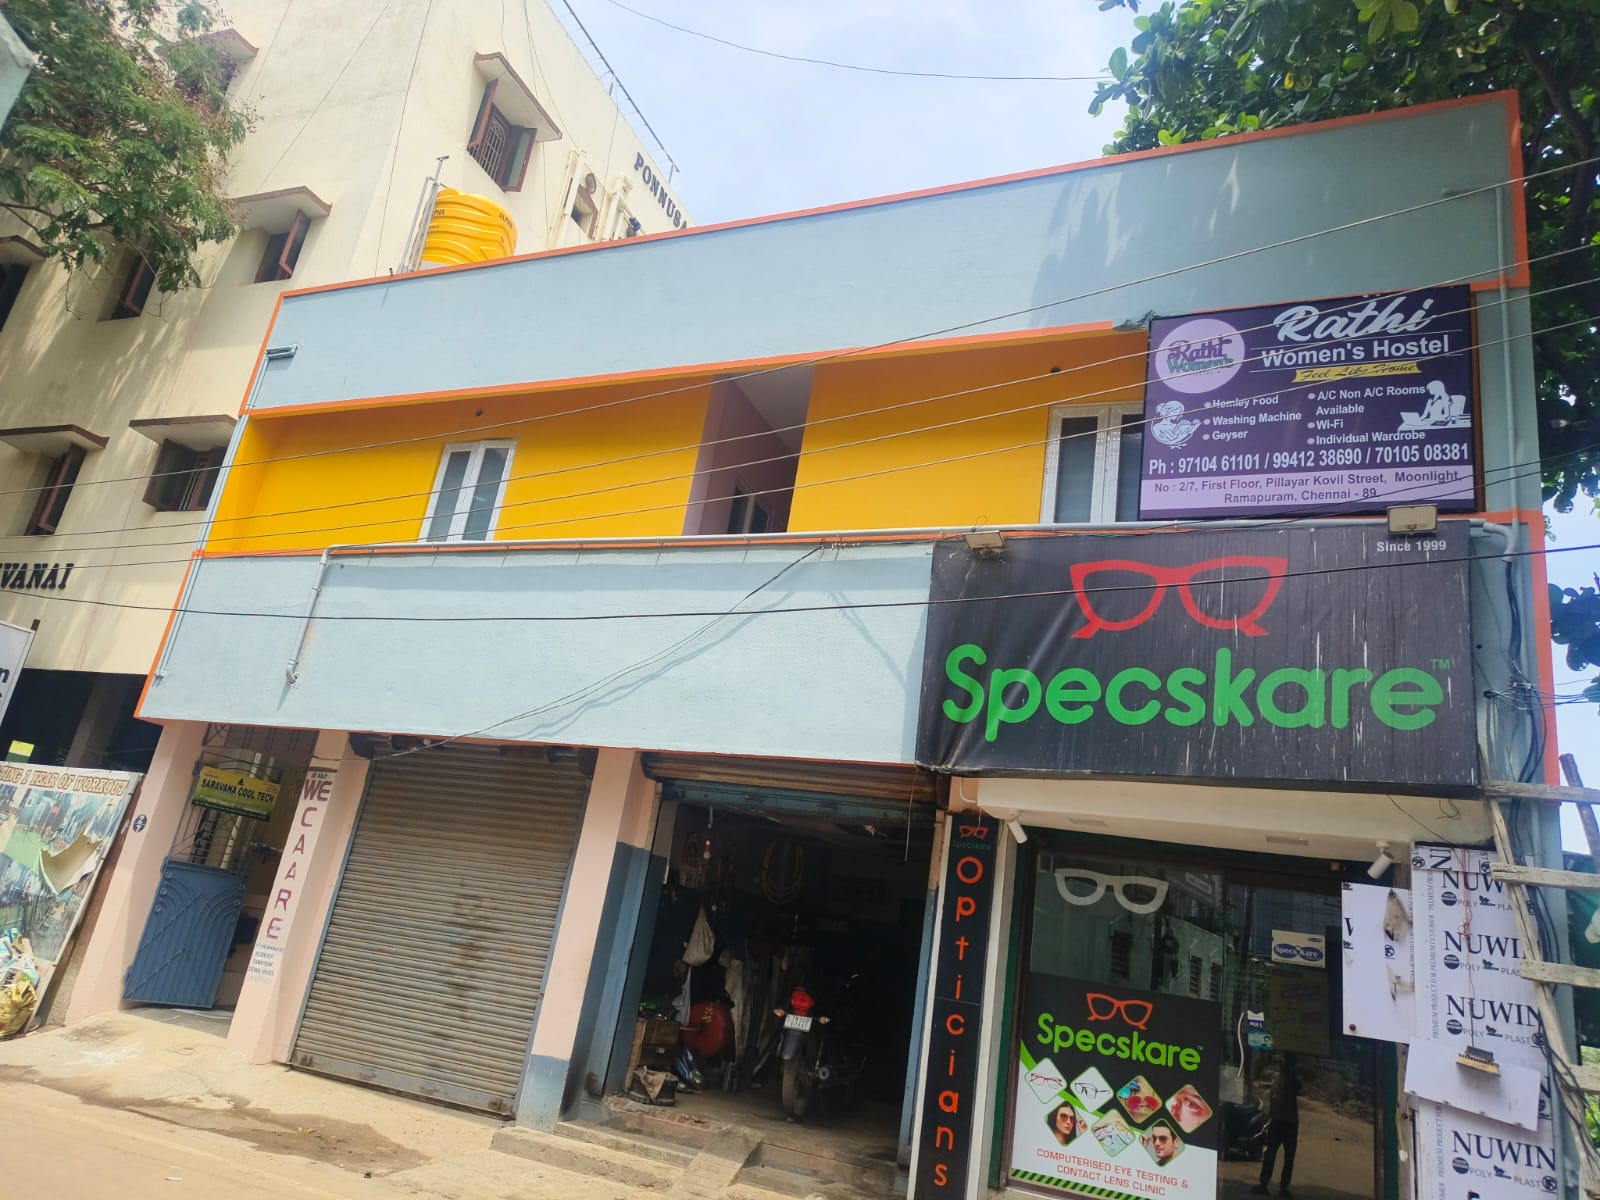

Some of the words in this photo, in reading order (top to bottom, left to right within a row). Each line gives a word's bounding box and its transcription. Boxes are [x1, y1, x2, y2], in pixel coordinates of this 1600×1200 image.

[1273, 296, 1437, 342] Rathi
[1261, 343, 1365, 367] Women's
[1373, 334, 1449, 358] Hostel
[1300, 369, 1329, 381] Feel
[1253, 395, 1279, 406] Food
[1317, 391, 1336, 401] A/C
[1340, 390, 1361, 399] Non
[1364, 387, 1384, 397] A/C
[1386, 386, 1426, 396] Rooms
[1212, 415, 1256, 426] Washing
[1258, 411, 1302, 422] Machine
[1316, 404, 1365, 416] Available
[1212, 430, 1248, 442] Geyser
[1316, 419, 1344, 430] Wi-Fi
[1316, 433, 1369, 445] Individual
[1372, 430, 1426, 443] Wardrobe
[1149, 459, 1166, 475] Ph
[1178, 456, 1217, 474] 97104
[1221, 453, 1260, 471] 61101
[1272, 450, 1315, 469] 99412
[1319, 448, 1362, 466] 38690
[1375, 445, 1419, 463] 70105
[1423, 443, 1469, 461] 08381
[1154, 483, 1169, 493] No
[1179, 481, 1198, 493] 2/7,
[1201, 480, 1227, 490] First
[1230, 479, 1262, 490] Floor,
[1266, 477, 1310, 489] Pillayar
[1313, 475, 1343, 486] Kovil
[1347, 473, 1387, 485] Street,
[1224, 492, 1297, 504] Ramapuram,
[1301, 489, 1351, 501] Chennai
[1376, 540, 1411, 553] Since
[1415, 540, 1447, 552] 1999
[0, 563, 74, 590] VANAI
[942, 643, 1444, 742] Specskare
[29, 770, 60, 789] YEAR
[58, 773, 75, 790] OF
[73, 775, 129, 797] WORKOUT
[201, 778, 237, 796] SARAVANA
[237, 787, 255, 800] COOL
[257, 791, 274, 803] TECH
[303, 779, 333, 801] WE
[1443, 930, 1527, 960] NUWI
[1501, 968, 1521, 977] PLAS
[1446, 994, 1541, 1027] NUWIN
[1036, 1013, 1201, 1071] Specskare
[1452, 1130, 1556, 1172] NUWIN
[1036, 1148, 1112, 1172] COMPUTERISED
[1114, 1165, 1133, 1177] EYE
[1136, 1169, 1178, 1187] TESTING
[1181, 1179, 1189, 1189] &
[1057, 1164, 1100, 1182] CONTACT
[1104, 1175, 1130, 1189] LENS
[1133, 1180, 1166, 1196] CLINIC
